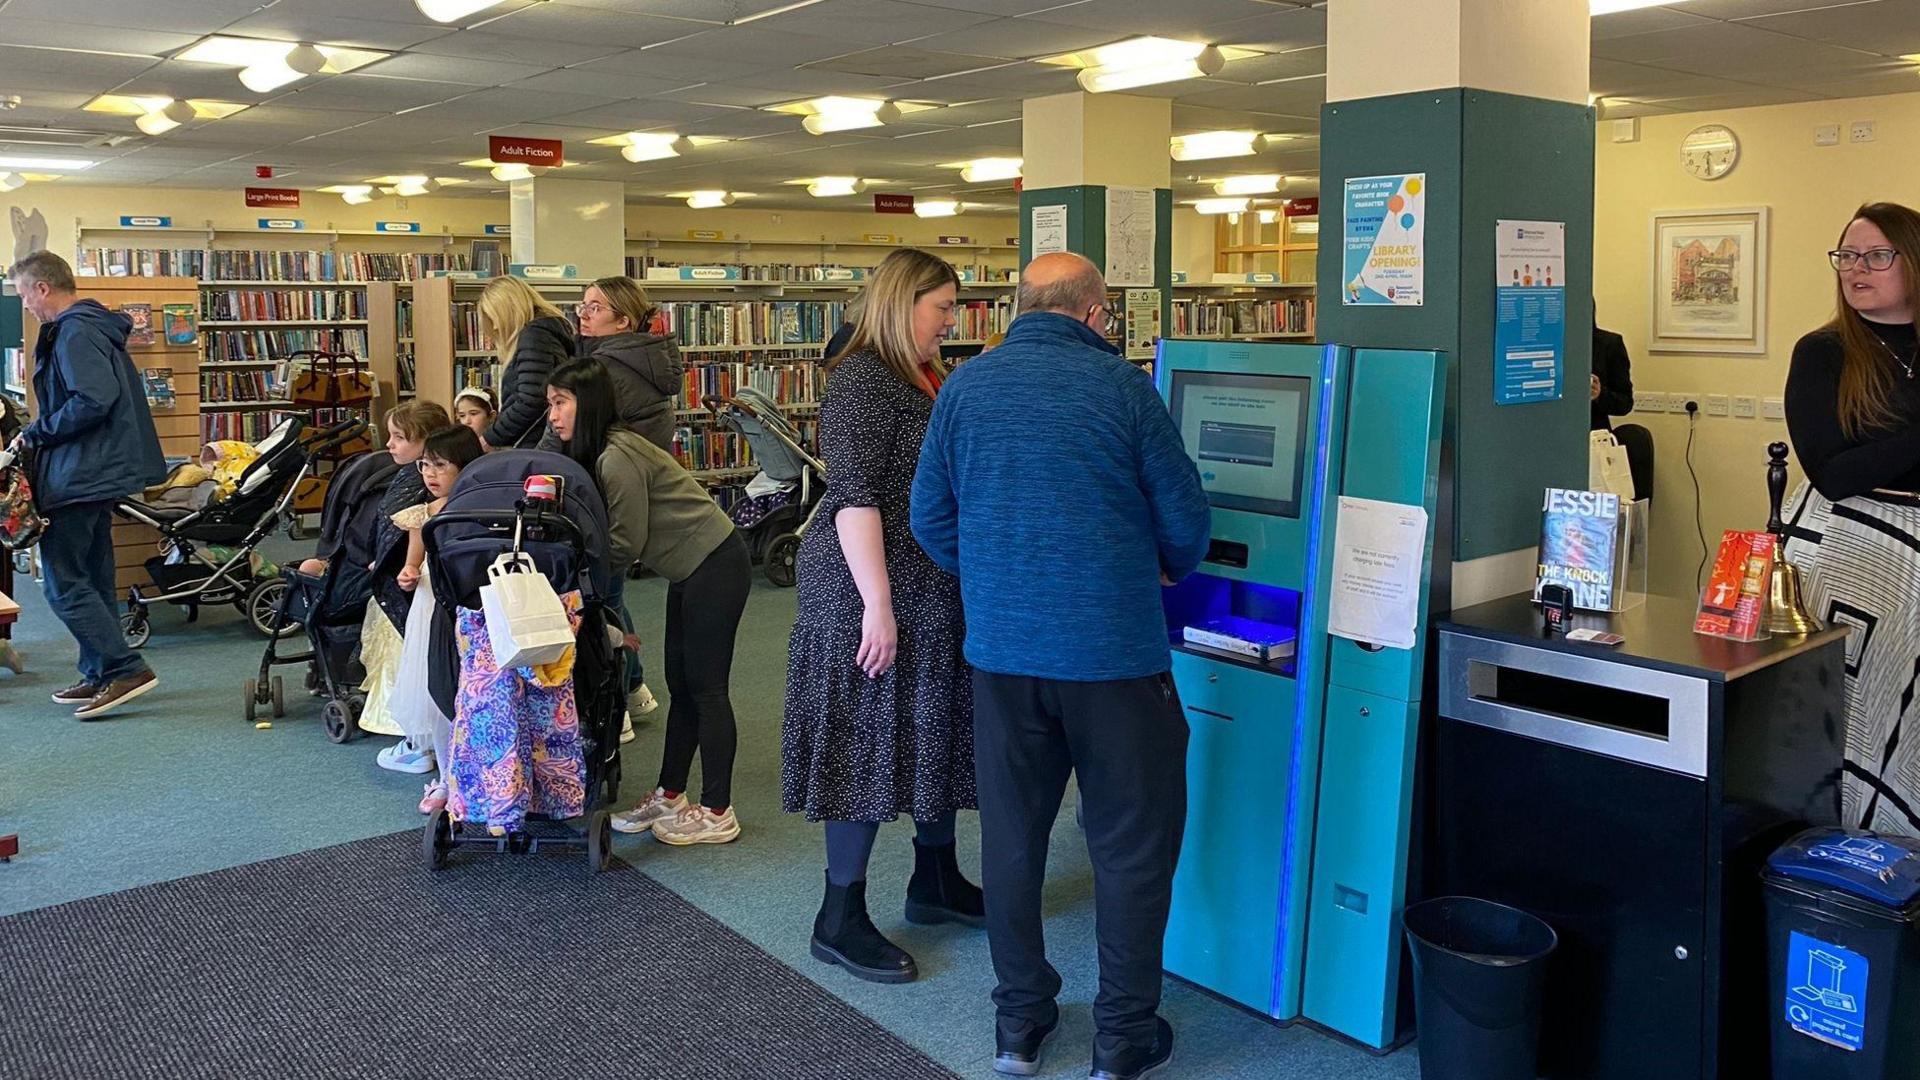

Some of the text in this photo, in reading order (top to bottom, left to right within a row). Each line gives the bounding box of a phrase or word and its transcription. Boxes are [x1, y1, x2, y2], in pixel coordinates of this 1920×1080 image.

[501, 146, 554, 158] Adult Fiction
[248, 194, 264, 202] Large
[1374, 246, 1417, 257] LIBRARY
[1370, 257, 1420, 268] OPENING!
[1542, 488, 1617, 519] JESSIE
[1353, 557, 1373, 567] charging
[1378, 554, 1400, 562] currently
[1539, 564, 1608, 584] THE KNOCK
[1535, 578, 1609, 610] KANE
[1813, 1021, 1834, 1034] paper
[1843, 1033, 1860, 1043] card
